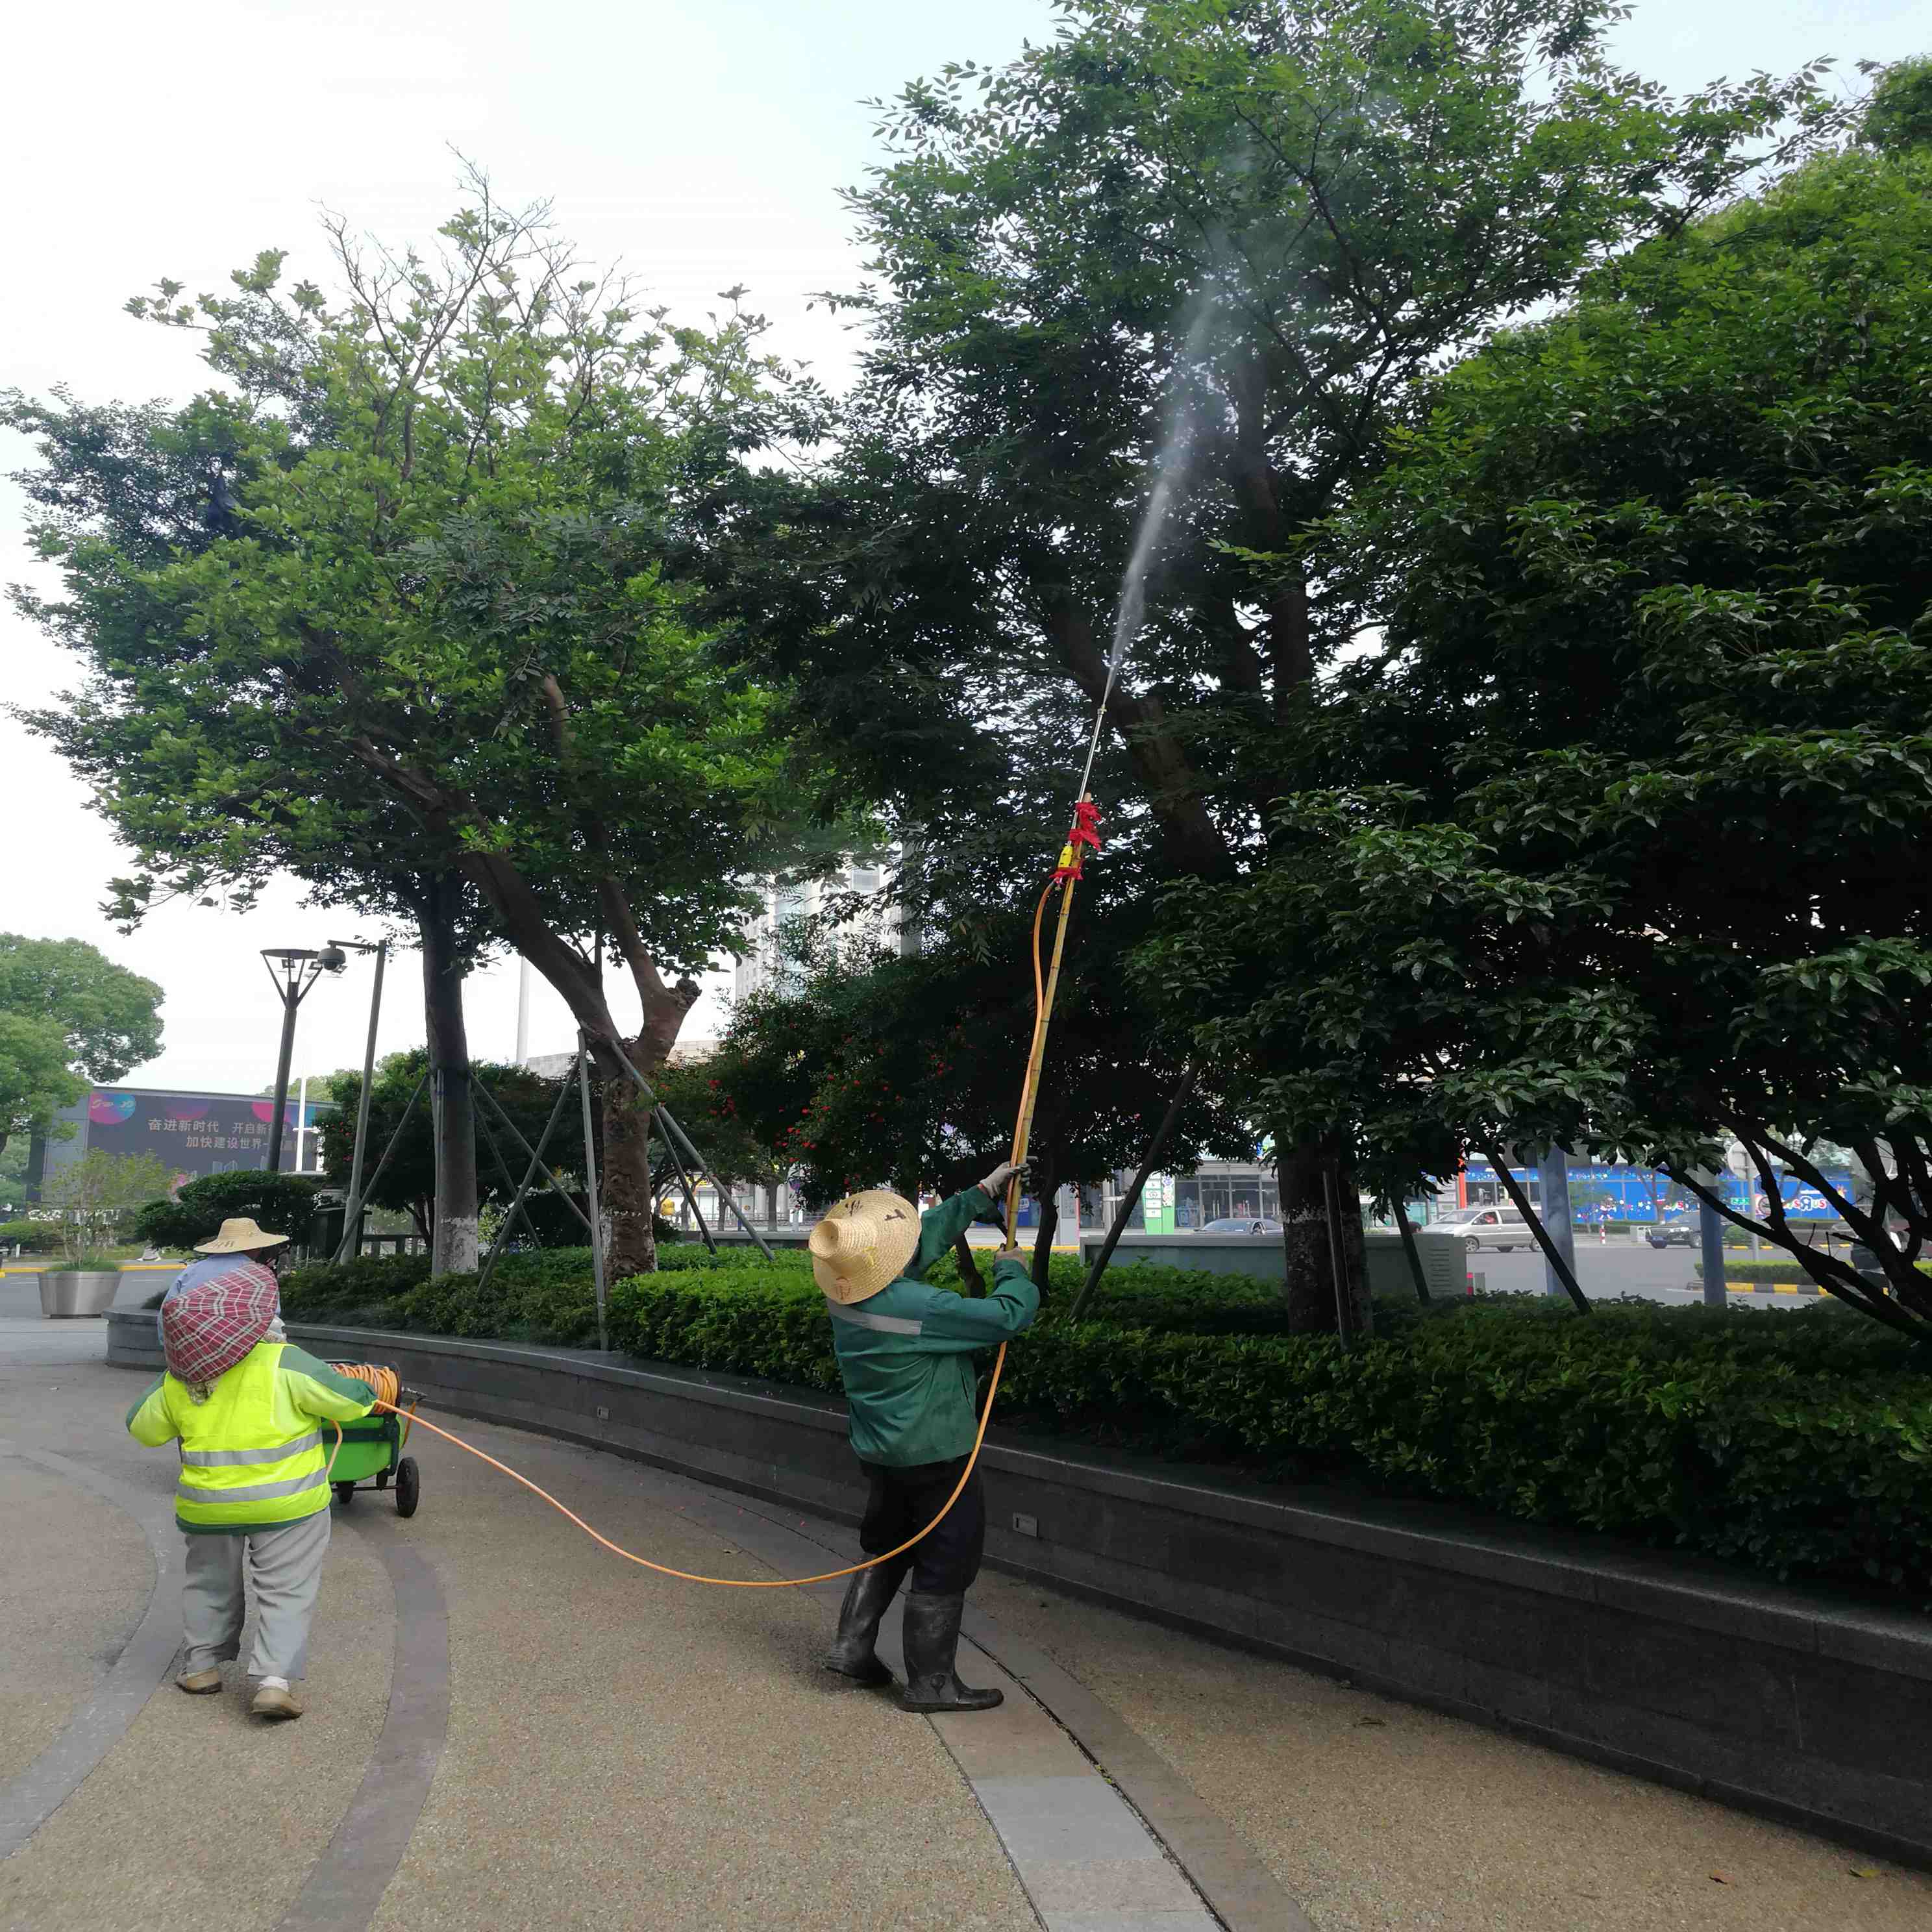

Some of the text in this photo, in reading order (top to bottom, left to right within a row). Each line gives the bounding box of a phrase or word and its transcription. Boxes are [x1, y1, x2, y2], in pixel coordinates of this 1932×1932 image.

[148, 1118, 218, 1133] 奋进新时代
